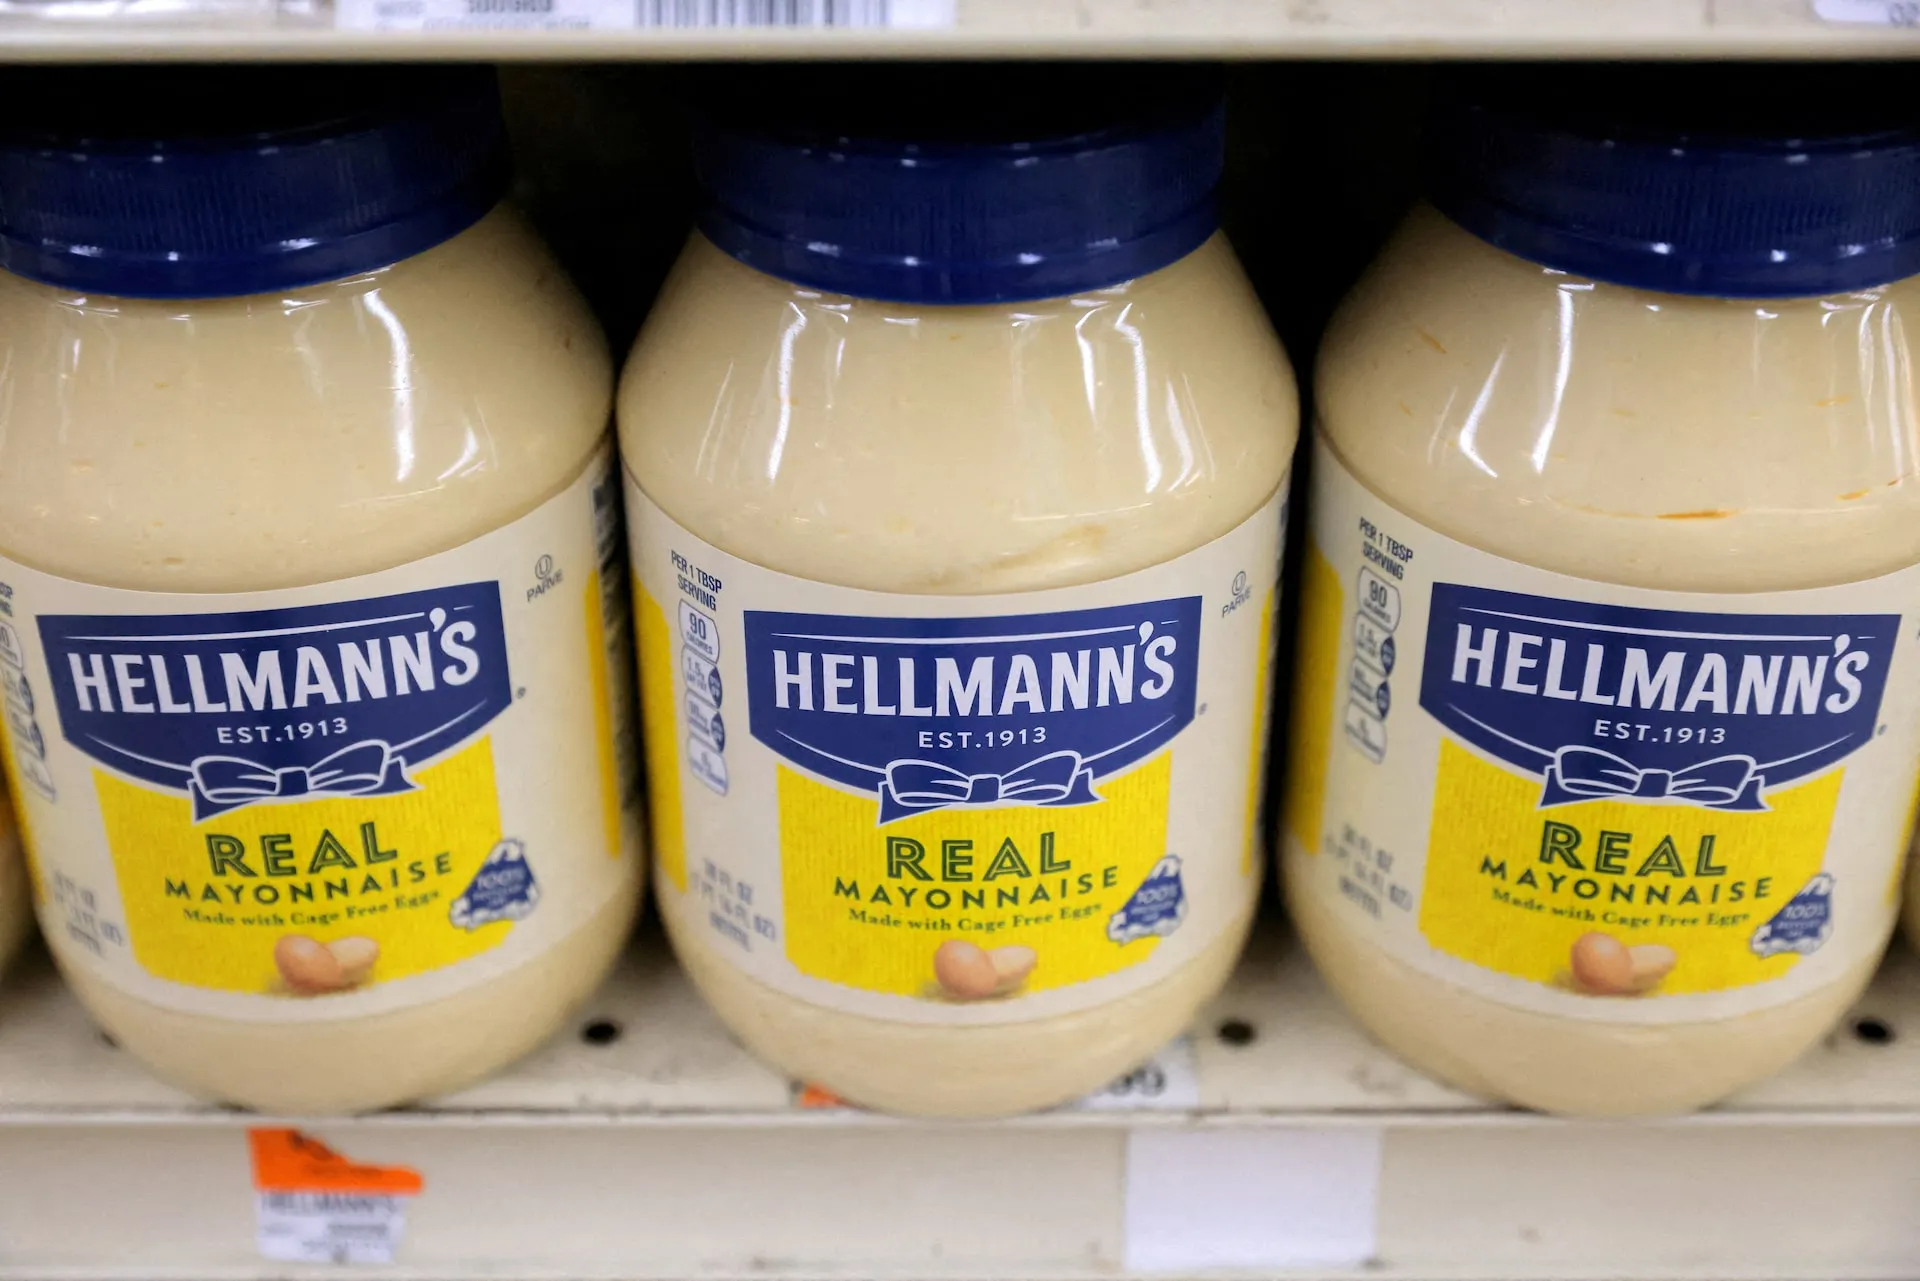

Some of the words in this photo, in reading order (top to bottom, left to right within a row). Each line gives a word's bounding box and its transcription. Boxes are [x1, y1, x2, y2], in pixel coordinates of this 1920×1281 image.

[1359, 516, 1377, 541] PER
[1386, 536, 1413, 563] TBSP
[1362, 540, 1404, 580] SERVING
[526, 569, 563, 602] PARVE
[671, 550, 688, 574] PER
[690, 565, 694, 578] 1
[696, 567, 722, 594] TBSP
[678, 574, 716, 611] SERVING
[1222, 585, 1253, 618] PARVE
[689, 613, 706, 640] 90
[67, 608, 480, 713] HELLMANN'S
[772, 621, 1177, 717] HELLMANN'S
[1451, 623, 1870, 715] HELLMANN'S
[205, 821, 398, 877] REAL
[886, 831, 1072, 882] REAL
[1539, 820, 1729, 877] REAL
[165, 852, 453, 905] MAYONNAISE
[834, 865, 1119, 910] MAYONNAISE
[1480, 855, 1773, 906] MAYONNAISE
[183, 907, 235, 926] Made
[241, 909, 284, 926] with
[291, 908, 339, 926] Cage
[346, 900, 389, 919] Free
[394, 888, 440, 910] Eggs
[849, 908, 901, 928] Made
[908, 915, 952, 932] with
[958, 917, 1006, 934] Cage
[1013, 911, 1053, 927] Free
[1060, 902, 1103, 920] Eggs
[1492, 888, 1546, 912] Made
[1552, 905, 1596, 922] with
[1602, 912, 1651, 928] Cage
[1658, 911, 1698, 927] Free
[1706, 911, 1750, 927] Eggs
